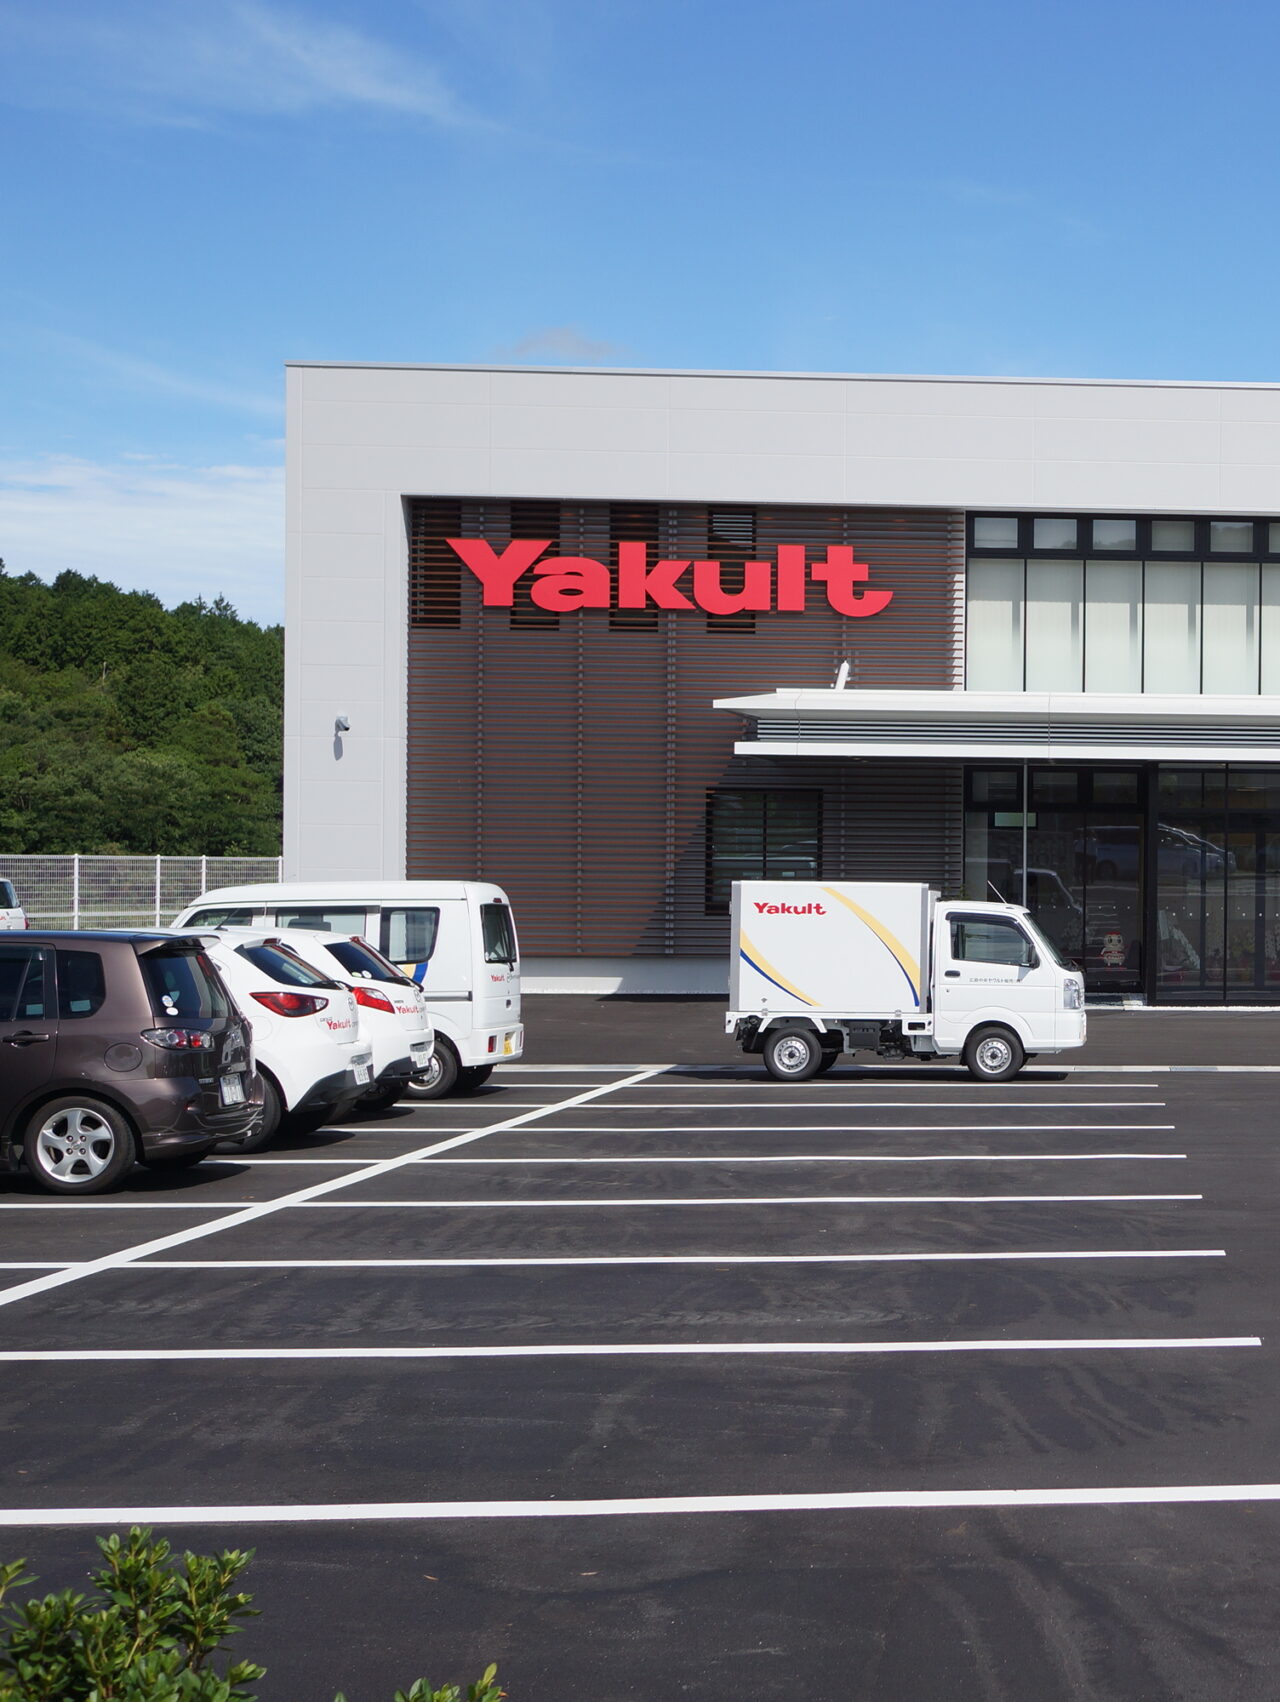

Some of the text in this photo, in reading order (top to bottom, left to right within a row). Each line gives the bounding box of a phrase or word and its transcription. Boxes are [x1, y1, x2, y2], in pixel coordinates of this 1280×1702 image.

[445, 538, 894, 617] Yakult
[753, 902, 828, 915] Yakult
[395, 1005, 420, 1014] Yakult
[326, 1018, 352, 1030] Yakult
